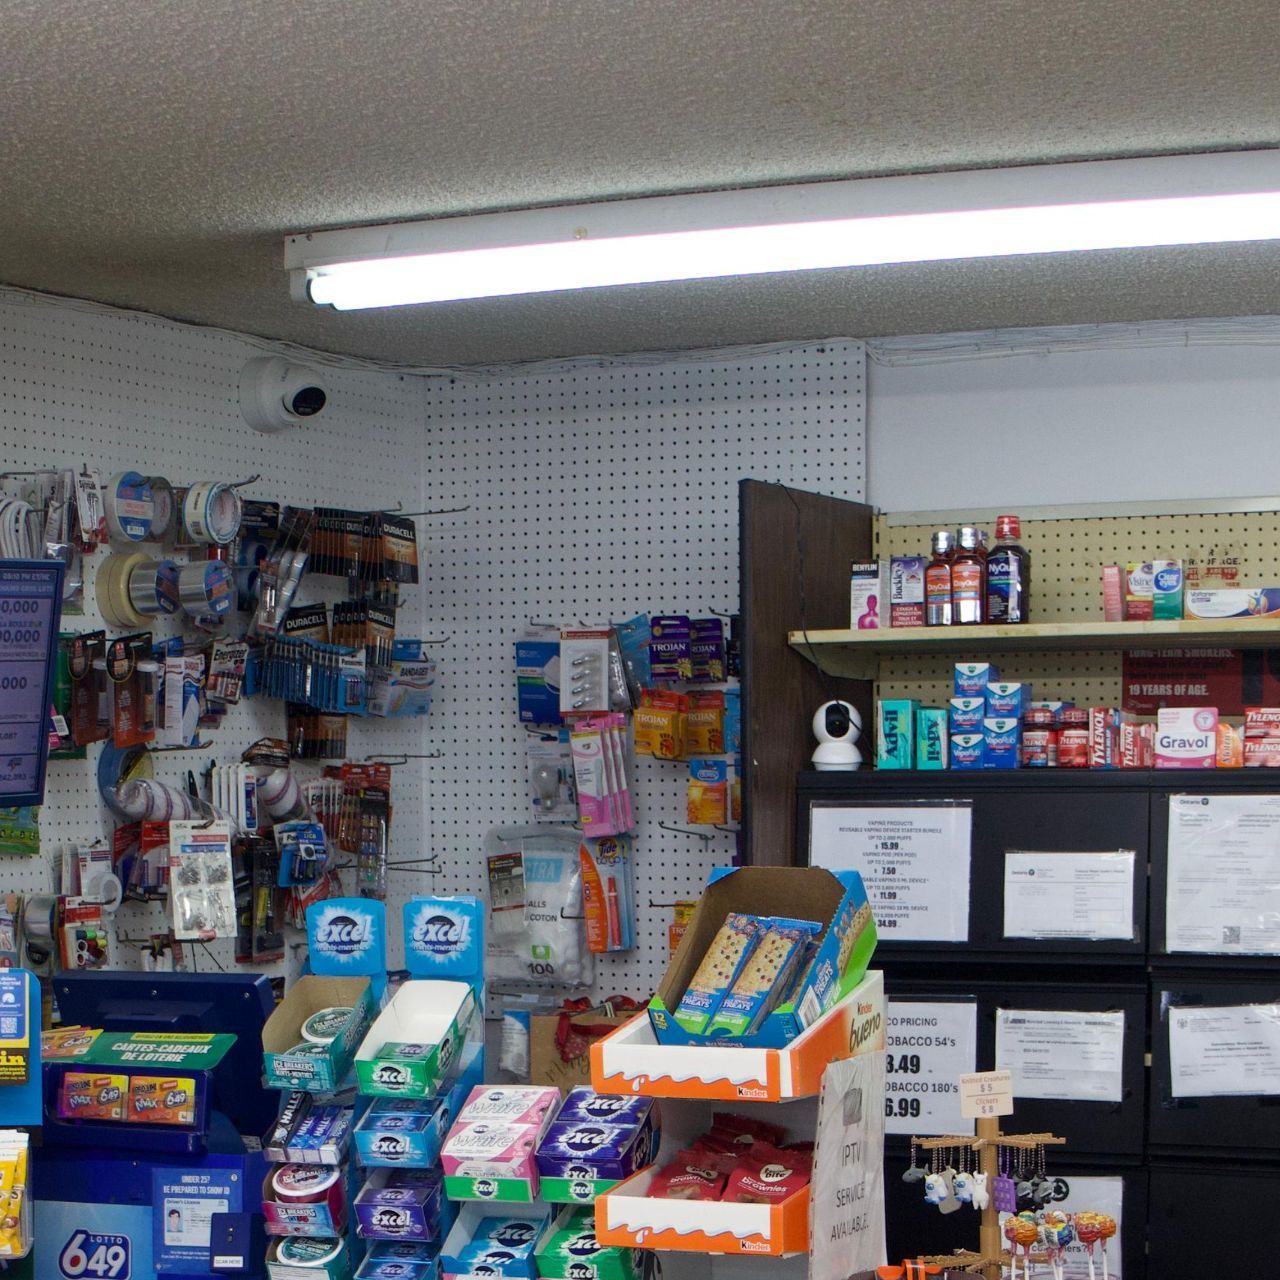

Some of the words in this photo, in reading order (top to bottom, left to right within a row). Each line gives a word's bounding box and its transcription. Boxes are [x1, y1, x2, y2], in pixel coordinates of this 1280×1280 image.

[652, 641, 686, 655] TROJAN
[885, 710, 899, 758] Advil
[1092, 710, 1105, 767] TYLENOL
[1159, 734, 1209, 750] Gravol
[881, 842, 899, 850] 15.99
[882, 867, 896, 875] 7.50
[880, 892, 897, 900] 11.99
[878, 919, 897, 927] 34.99
[315, 918, 371, 943] excel
[899, 1017, 938, 1027] PRICING
[935, 1036, 956, 1047] 54's
[112, 1043, 212, 1053] CARTES-CADEAUX
[121, 1052, 136, 1061] DE
[139, 1052, 185, 1063] LOTERIE
[932, 1082, 958, 1093] 180's
[841, 1142, 863, 1167] IPTV
[90, 1235, 123, 1244] LOTTO
[61, 1232, 129, 1278] 649
